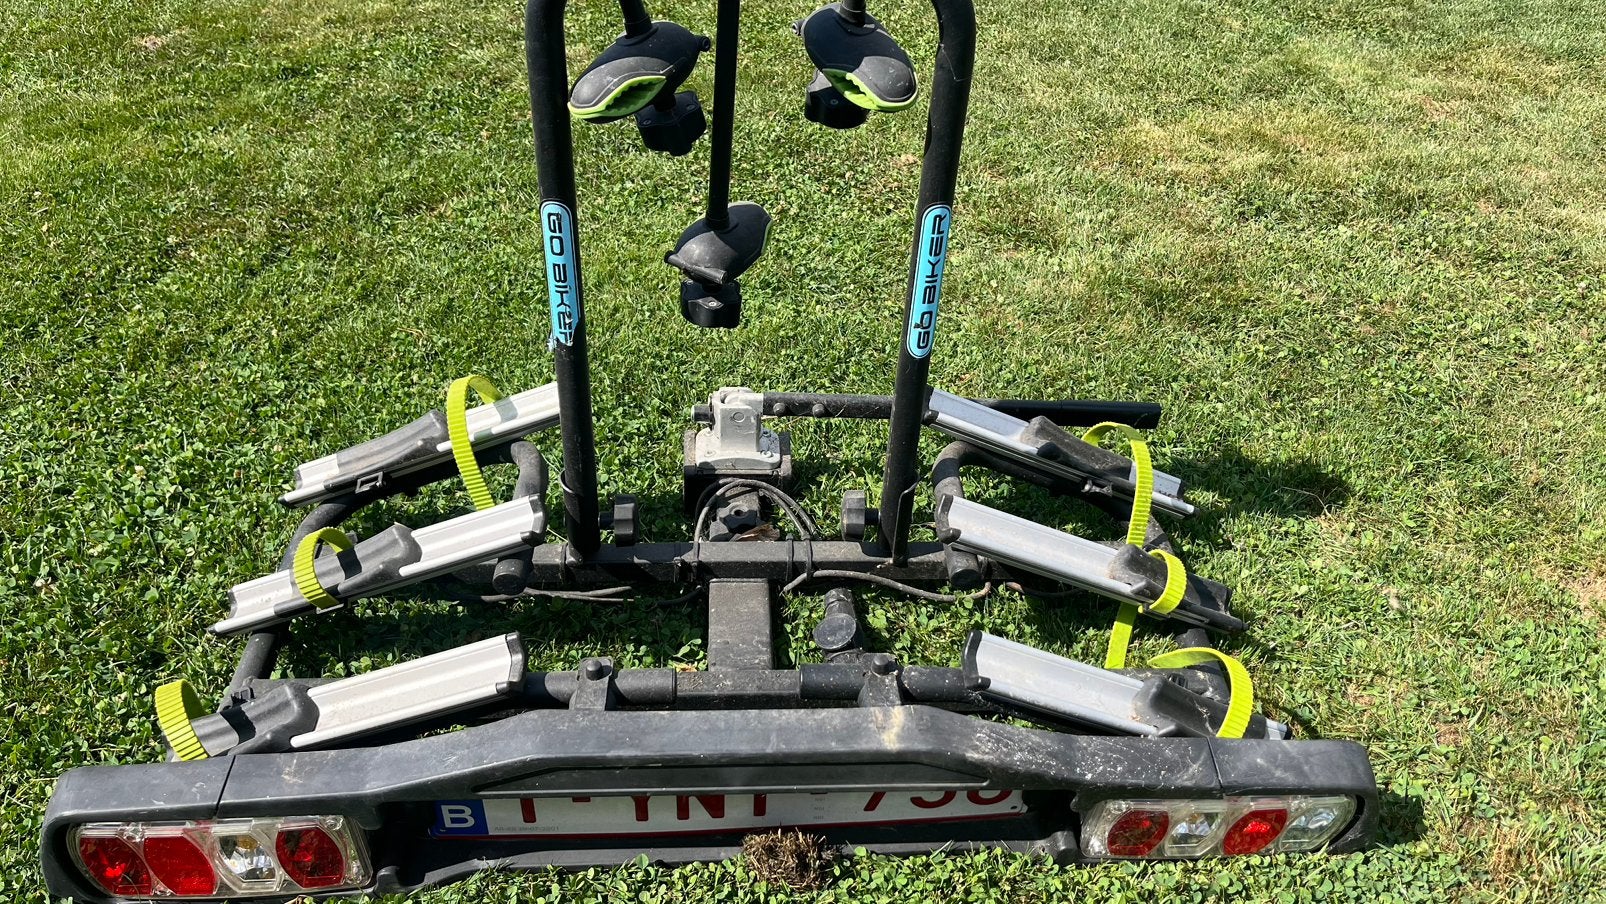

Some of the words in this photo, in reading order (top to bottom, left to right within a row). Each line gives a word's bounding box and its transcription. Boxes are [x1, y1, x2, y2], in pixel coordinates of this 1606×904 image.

[547, 211, 565, 257] GO
[921, 213, 948, 305] BIKER
[440, 804, 475, 828] B
